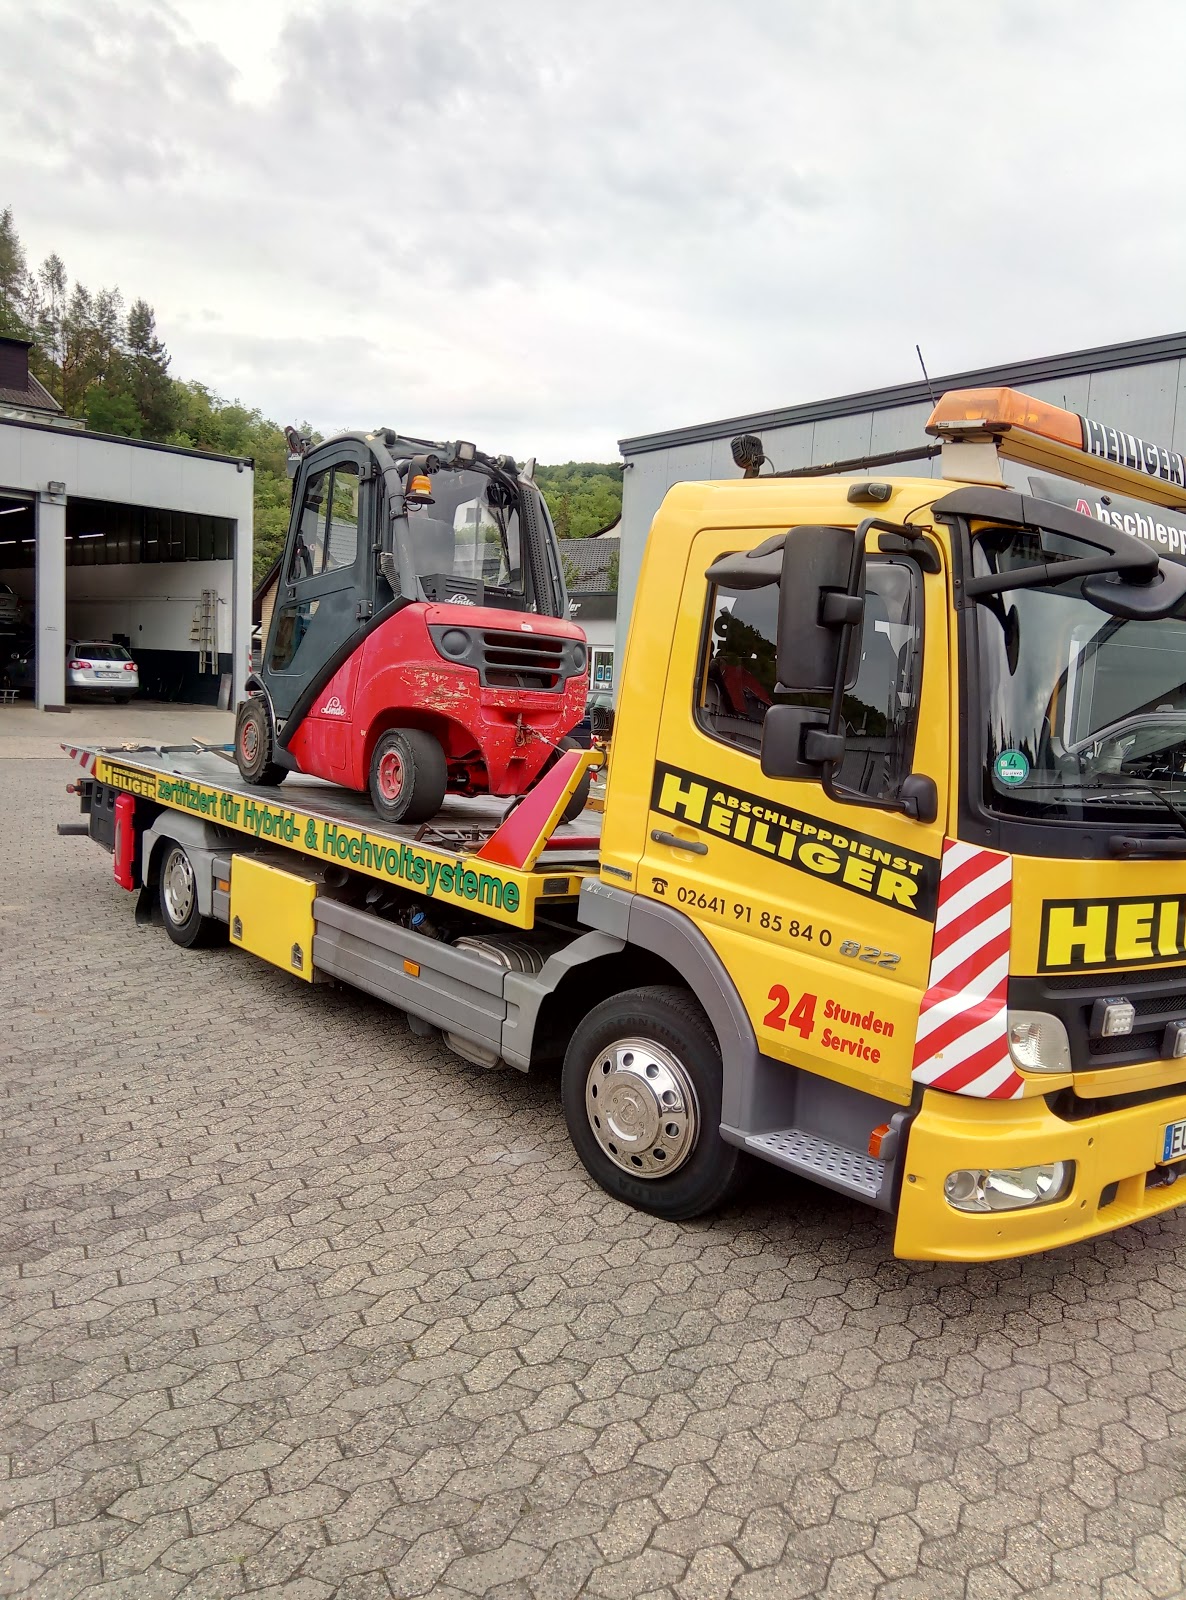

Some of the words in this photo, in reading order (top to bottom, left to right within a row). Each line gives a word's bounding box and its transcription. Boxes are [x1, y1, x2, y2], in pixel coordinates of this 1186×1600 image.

[1087, 418, 1183, 487] HEILIGER
[444, 594, 476, 606] Linde
[321, 696, 347, 716] Linde
[101, 763, 156, 799] HEILIGER
[1008, 754, 1018, 768] 4
[157, 779, 218, 817] zertifiziert
[220, 792, 241, 824] für
[243, 799, 300, 843] Hybrid-
[304, 818, 319, 851] &
[322, 822, 520, 913] Hochvoltsysteme
[658, 772, 919, 910] HEILIGER
[712, 791, 924, 876] ABSCHLEPPDIENST
[677, 886, 726, 915] 02641
[733, 903, 752, 923] 91
[759, 911, 783, 932] 85
[788, 920, 813, 942] 84
[819, 929, 832, 947] 0
[1045, 901, 1186, 967] HEI
[838, 939, 901, 971] 822
[763, 984, 818, 1040] 24
[823, 999, 895, 1038] Stunden
[821, 1028, 881, 1064] Service
